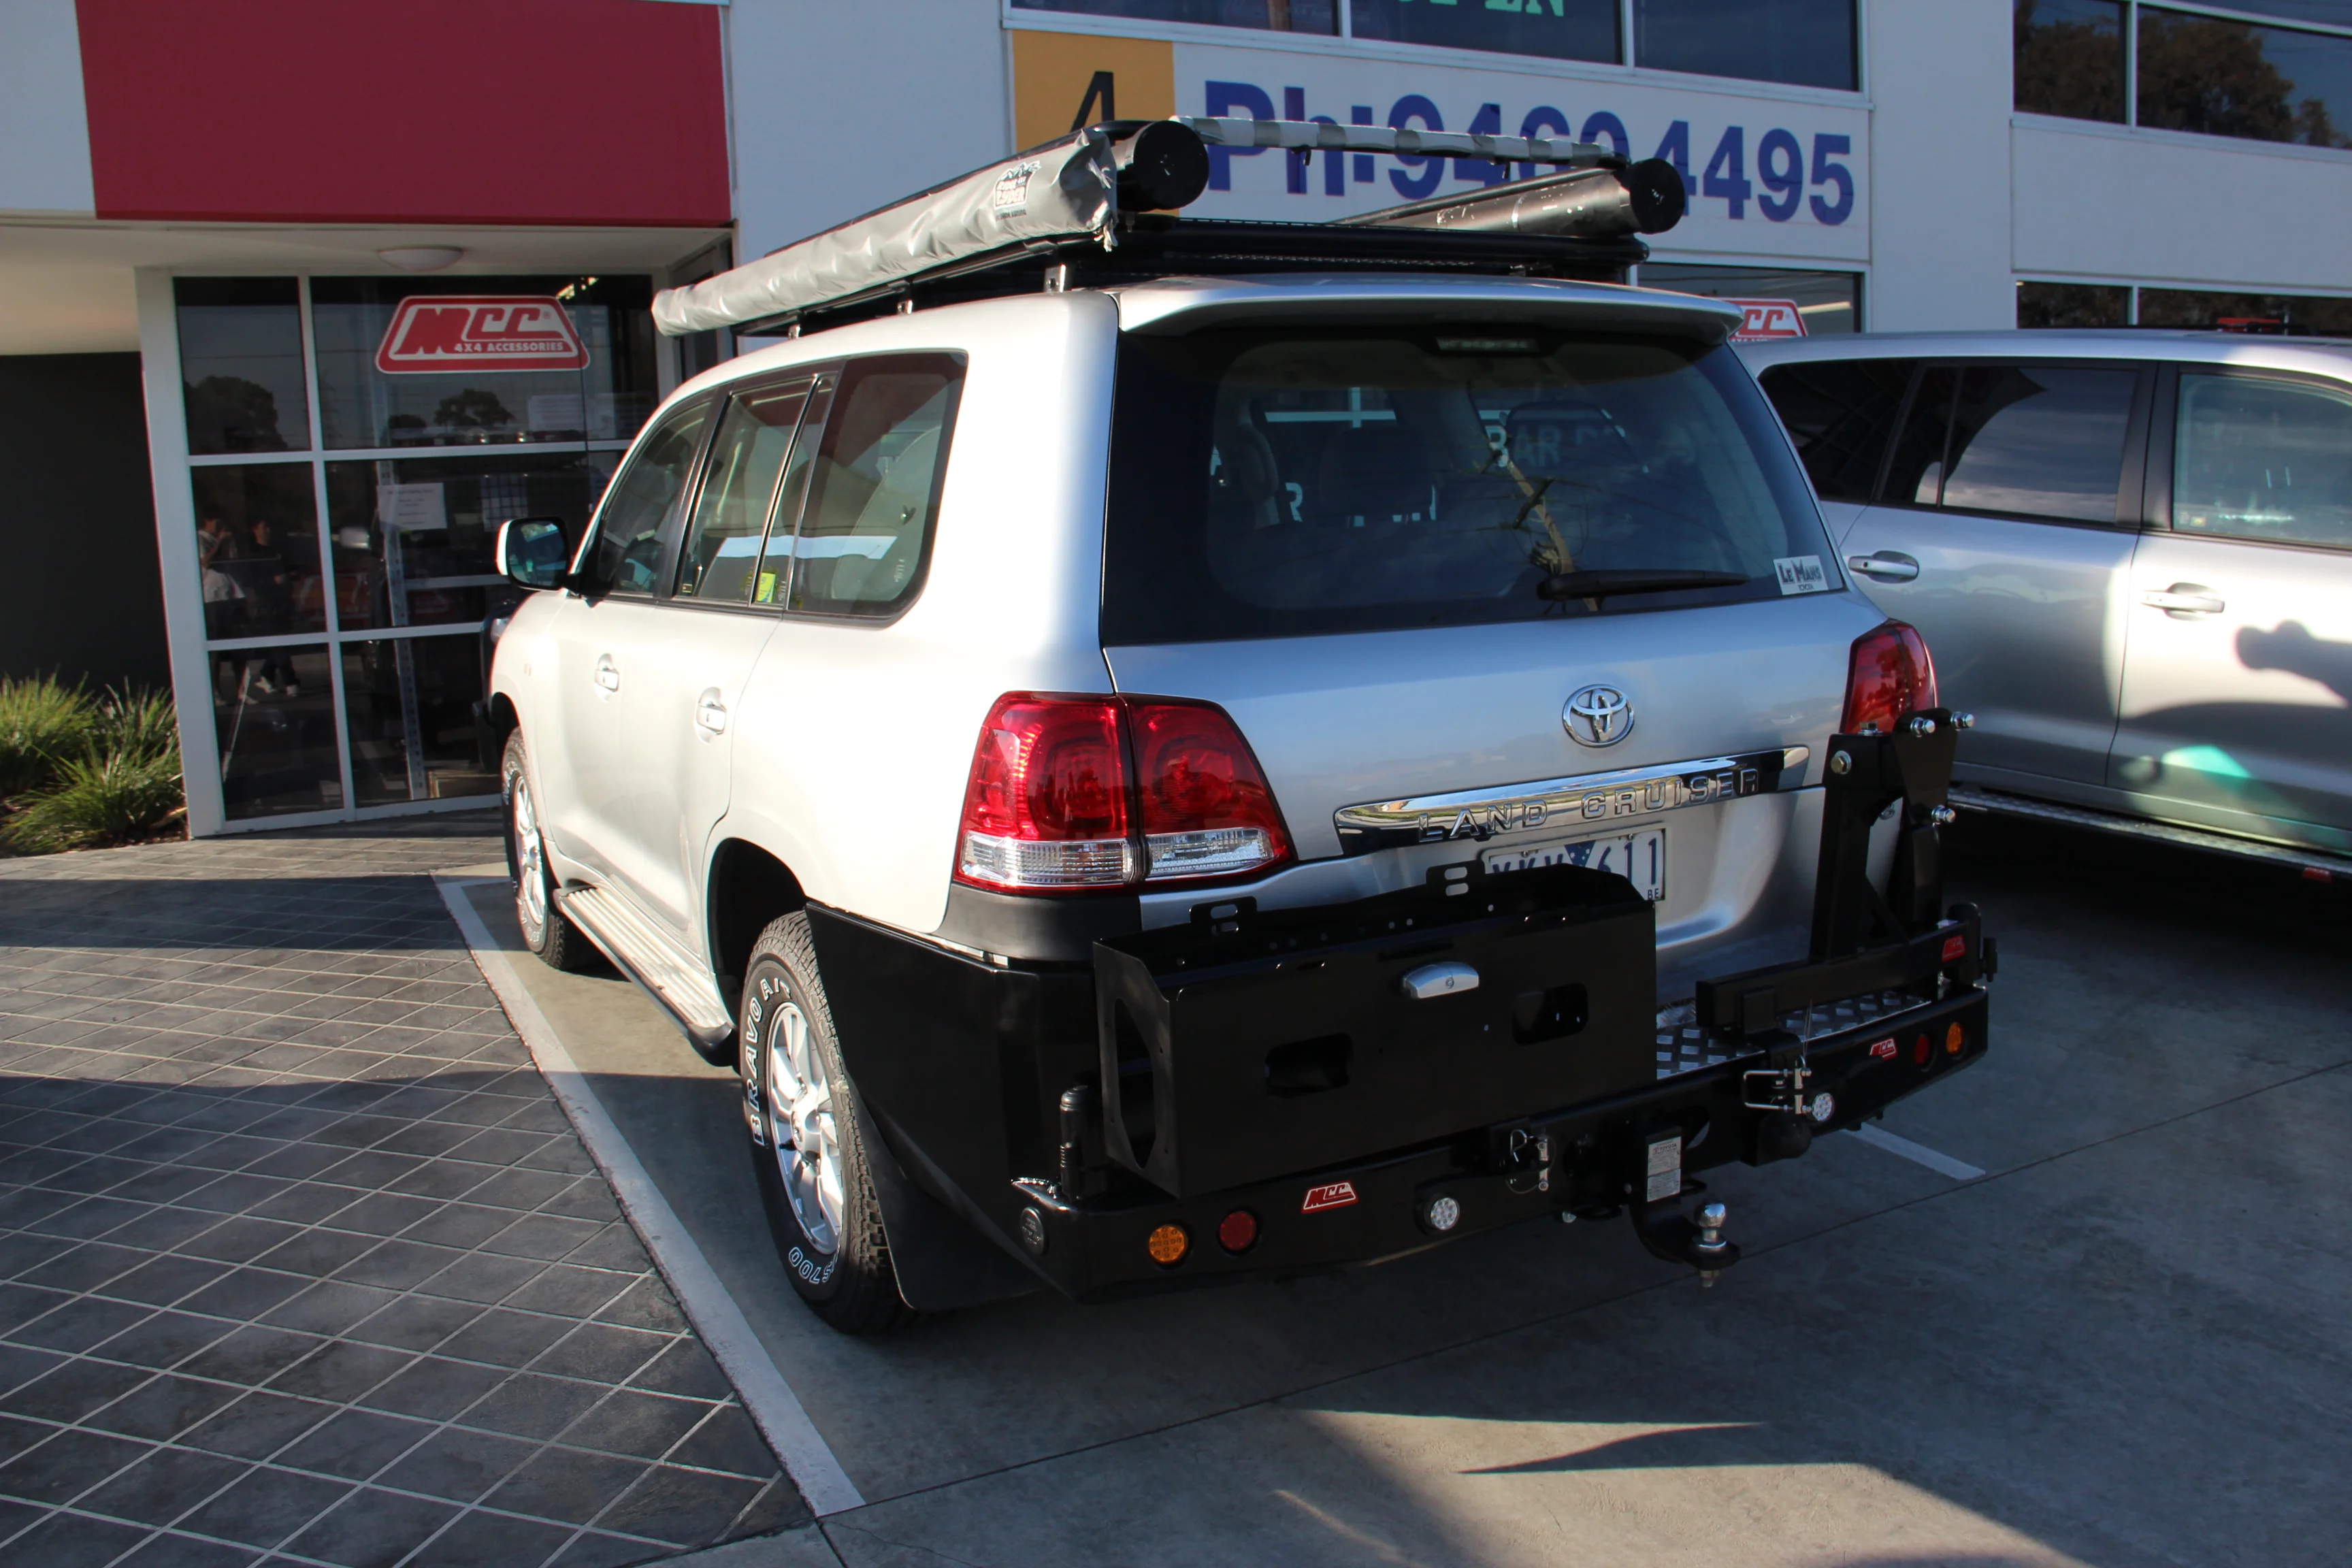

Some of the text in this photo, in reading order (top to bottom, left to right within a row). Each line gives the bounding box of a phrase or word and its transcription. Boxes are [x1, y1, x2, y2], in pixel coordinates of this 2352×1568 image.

[454, 341, 564, 353] 4X4 ACCESSORIES
[1418, 768, 1759, 843] LAND CRUISER
[1647, 887, 1660, 900] BE
[745, 996, 766, 1146] BRAVO
